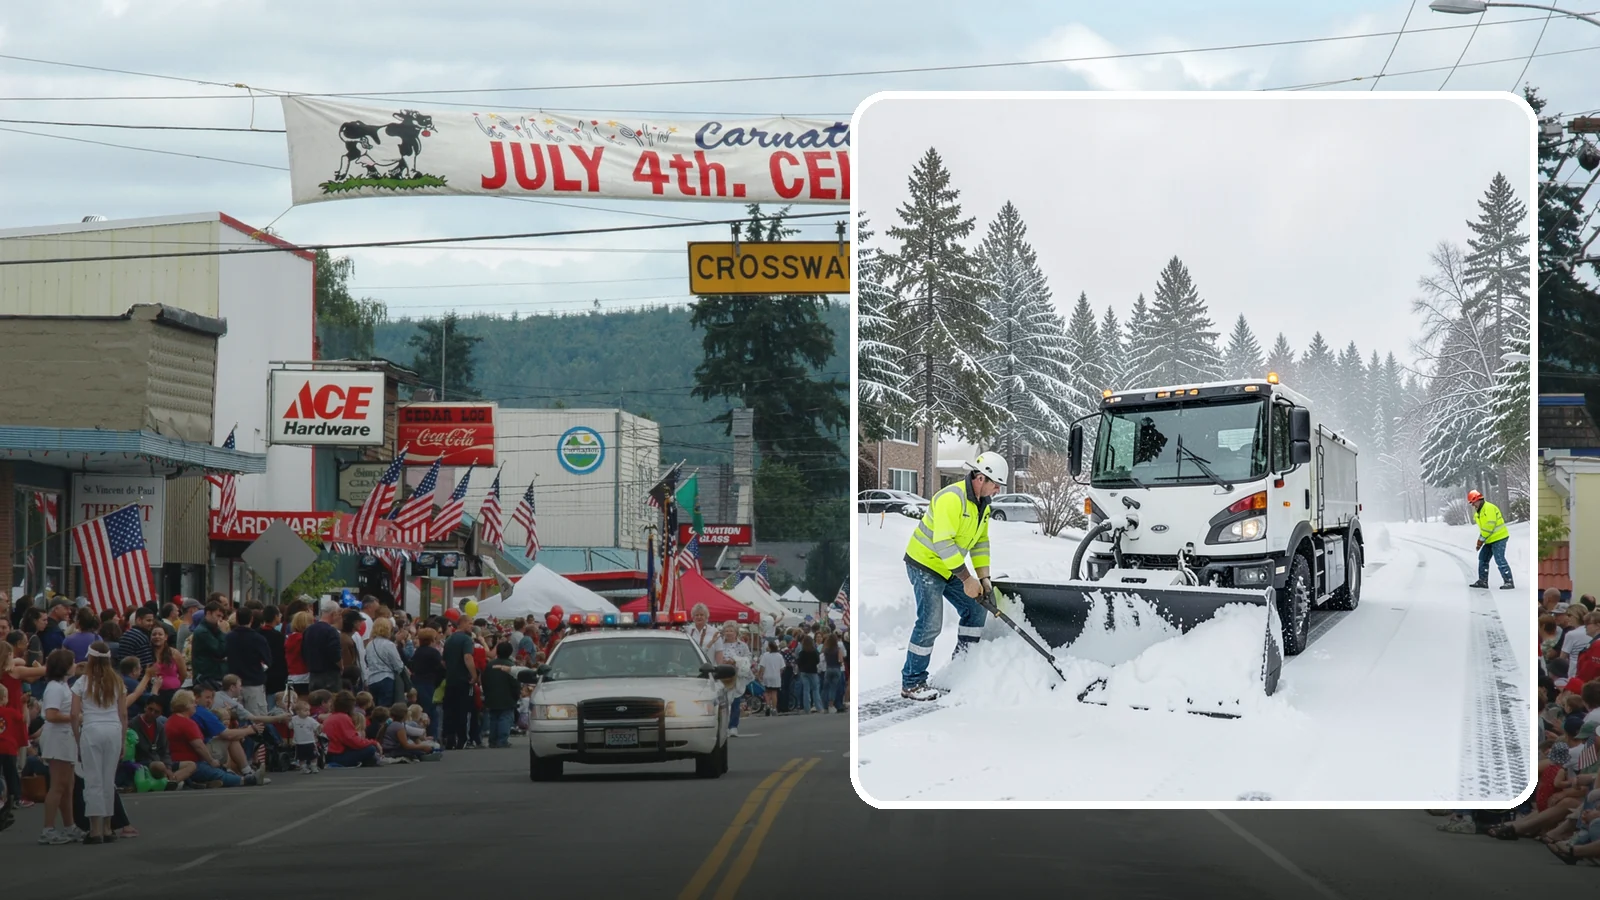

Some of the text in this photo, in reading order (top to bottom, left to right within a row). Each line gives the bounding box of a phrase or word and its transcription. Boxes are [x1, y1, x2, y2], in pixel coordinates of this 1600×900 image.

[481, 140, 604, 192] JULY
[632, 148, 746, 198] 4th.
[696, 254, 851, 280] CROSSWA
[283, 380, 374, 420] ACE
[405, 409, 485, 422] CEDAR LOG
[283, 420, 371, 436] Hardware
[416, 427, 477, 447] Coca-Cola
[353, 467, 386, 480] Simpl
[95, 485, 124, 495] Vincent
[126, 485, 136, 495] de
[137, 485, 155, 495] Paul
[212, 516, 331, 535] HARDARE
[688, 526, 741, 535] CRNATION
